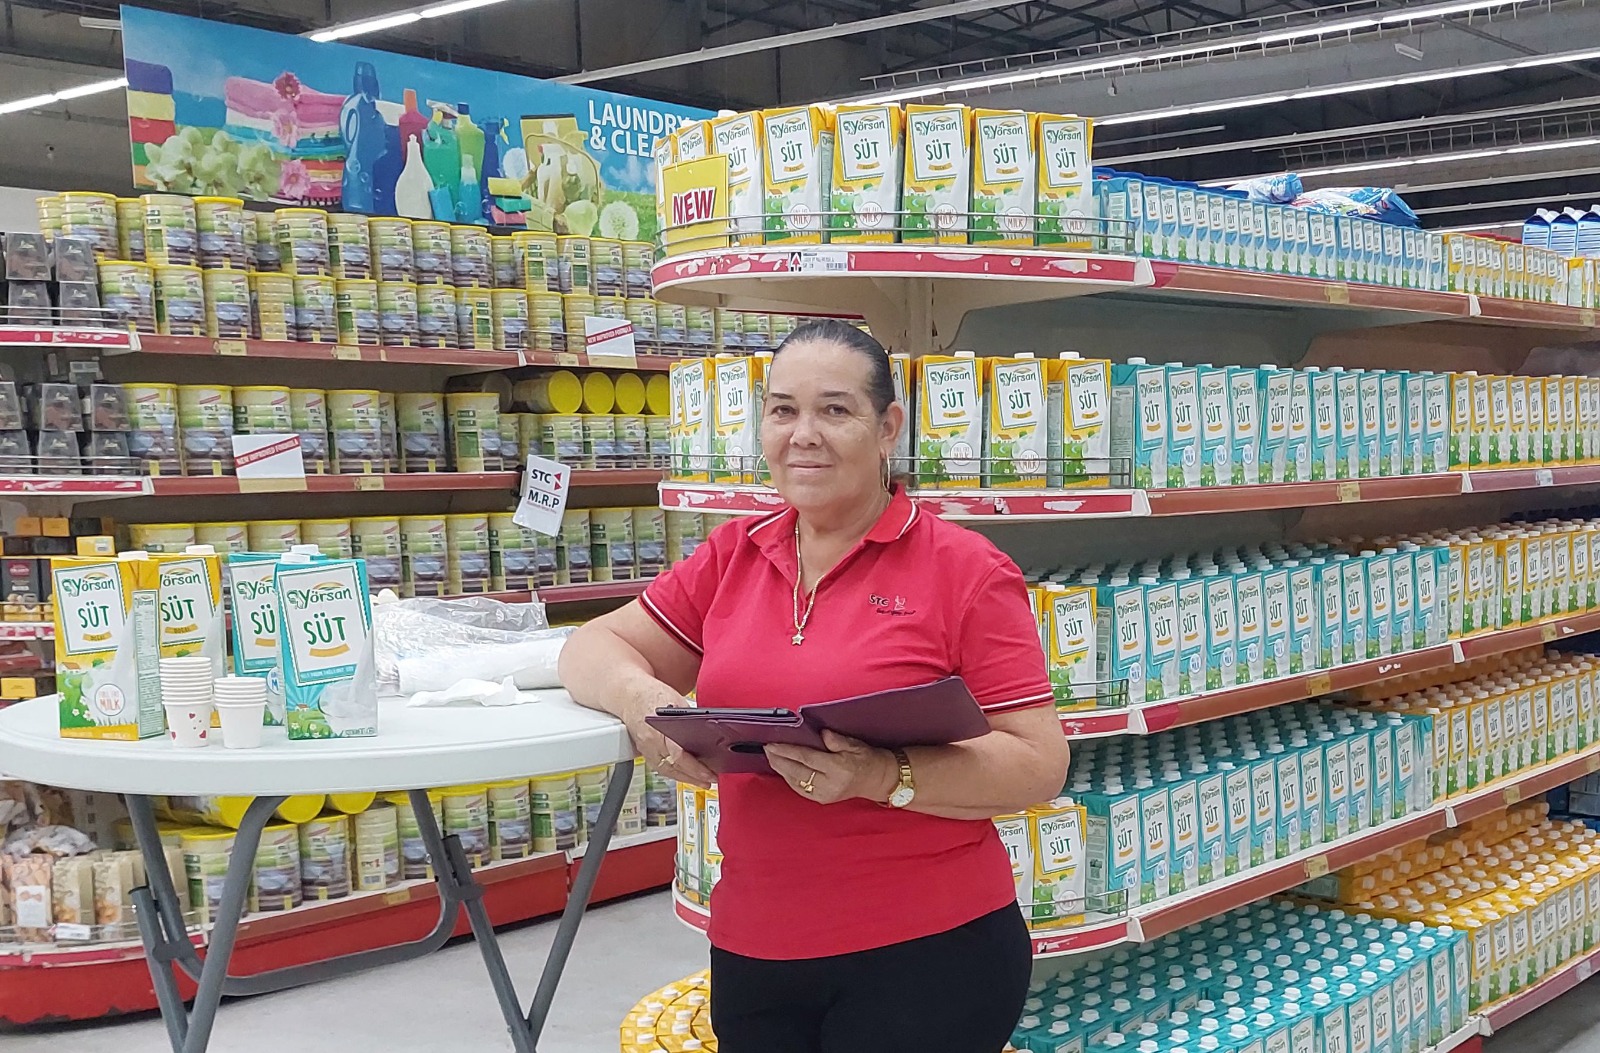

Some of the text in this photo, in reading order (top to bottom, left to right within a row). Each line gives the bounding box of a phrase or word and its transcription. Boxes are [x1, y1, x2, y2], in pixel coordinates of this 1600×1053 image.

[590, 126, 606, 150] &
[777, 121, 807, 138] Yörsan
[852, 121, 885, 135] Yörsan
[923, 121, 957, 135] Yörsan
[992, 125, 1024, 139] Yörsan
[1054, 130, 1082, 144] Yörsan
[728, 143, 747, 168] SÜT
[780, 141, 803, 163] SÜT
[853, 138, 879, 160] SÜT
[925, 139, 951, 161] SÜT
[993, 143, 1017, 164] SÜT
[1055, 148, 1077, 169] SÜT
[673, 189, 714, 225] NEW
[937, 370, 971, 385] Yörsan
[1006, 372, 1036, 386] Yörsan
[1077, 373, 1102, 387] Yörsan
[690, 388, 701, 408] SÜT
[727, 387, 743, 407] SÜT
[940, 388, 965, 409] SÜT
[1008, 389, 1031, 409] SÜT
[1079, 392, 1098, 410] SÜT
[1144, 400, 1160, 423] SÜT
[1175, 401, 1191, 424] SÜT
[1205, 402, 1221, 424] SÜT
[1236, 402, 1250, 423] SÜT
[1271, 403, 1285, 423] SÜT
[1291, 403, 1304, 423] SÜT
[1318, 403, 1331, 423] SÜT
[1342, 403, 1354, 423] SÜT
[1364, 402, 1375, 422] SÜT
[1386, 403, 1396, 422] SÜT
[1410, 402, 1419, 422] SÜT
[1429, 402, 1441, 421] SÜT
[531, 469, 552, 484] STC
[528, 490, 560, 508] M.R.P
[70, 577, 115, 597] Yörsan
[247, 581, 277, 599] Yör
[1373, 586, 1385, 604] SÜT
[1397, 582, 1408, 600] SÜT
[1420, 579, 1431, 597] SÜT
[160, 594, 194, 622] SÜT
[304, 587, 352, 609] Yörsan
[869, 594, 889, 607] STC
[1295, 597, 1308, 616] SÜT
[1326, 594, 1337, 612] SÜT
[1349, 590, 1361, 608] SÜT
[77, 601, 109, 629] SÜT
[1063, 601, 1087, 616] Yörsan
[1214, 608, 1228, 629] SÜT
[1241, 606, 1256, 625] SÜT
[1269, 602, 1282, 620] SÜT
[250, 603, 276, 635] SÜ
[303, 612, 346, 645] SÜT
[1064, 617, 1083, 637] SÜT
[1154, 616, 1171, 638] SÜT
[1182, 612, 1197, 633] SÜT
[1121, 619, 1137, 642] SÜT
[1331, 768, 1344, 789] SÜT
[1353, 761, 1365, 782] SÜT
[1282, 781, 1295, 803] SÜT
[1305, 774, 1317, 795] SÜT
[1232, 797, 1246, 818] SÜT
[1256, 788, 1270, 810] SÜT
[1176, 811, 1192, 834] SÜT
[1204, 804, 1219, 827] SÜT
[1047, 820, 1076, 834] Yörsan
[1148, 821, 1163, 843] SÜT
[1050, 836, 1071, 856] SÜT
[1117, 828, 1133, 850] SÜT
[1435, 974, 1445, 994] SÜT
[1413, 986, 1423, 1007] SÜT
[1376, 1012, 1387, 1035] SÜT
[1354, 1024, 1365, 1047] SÜT
